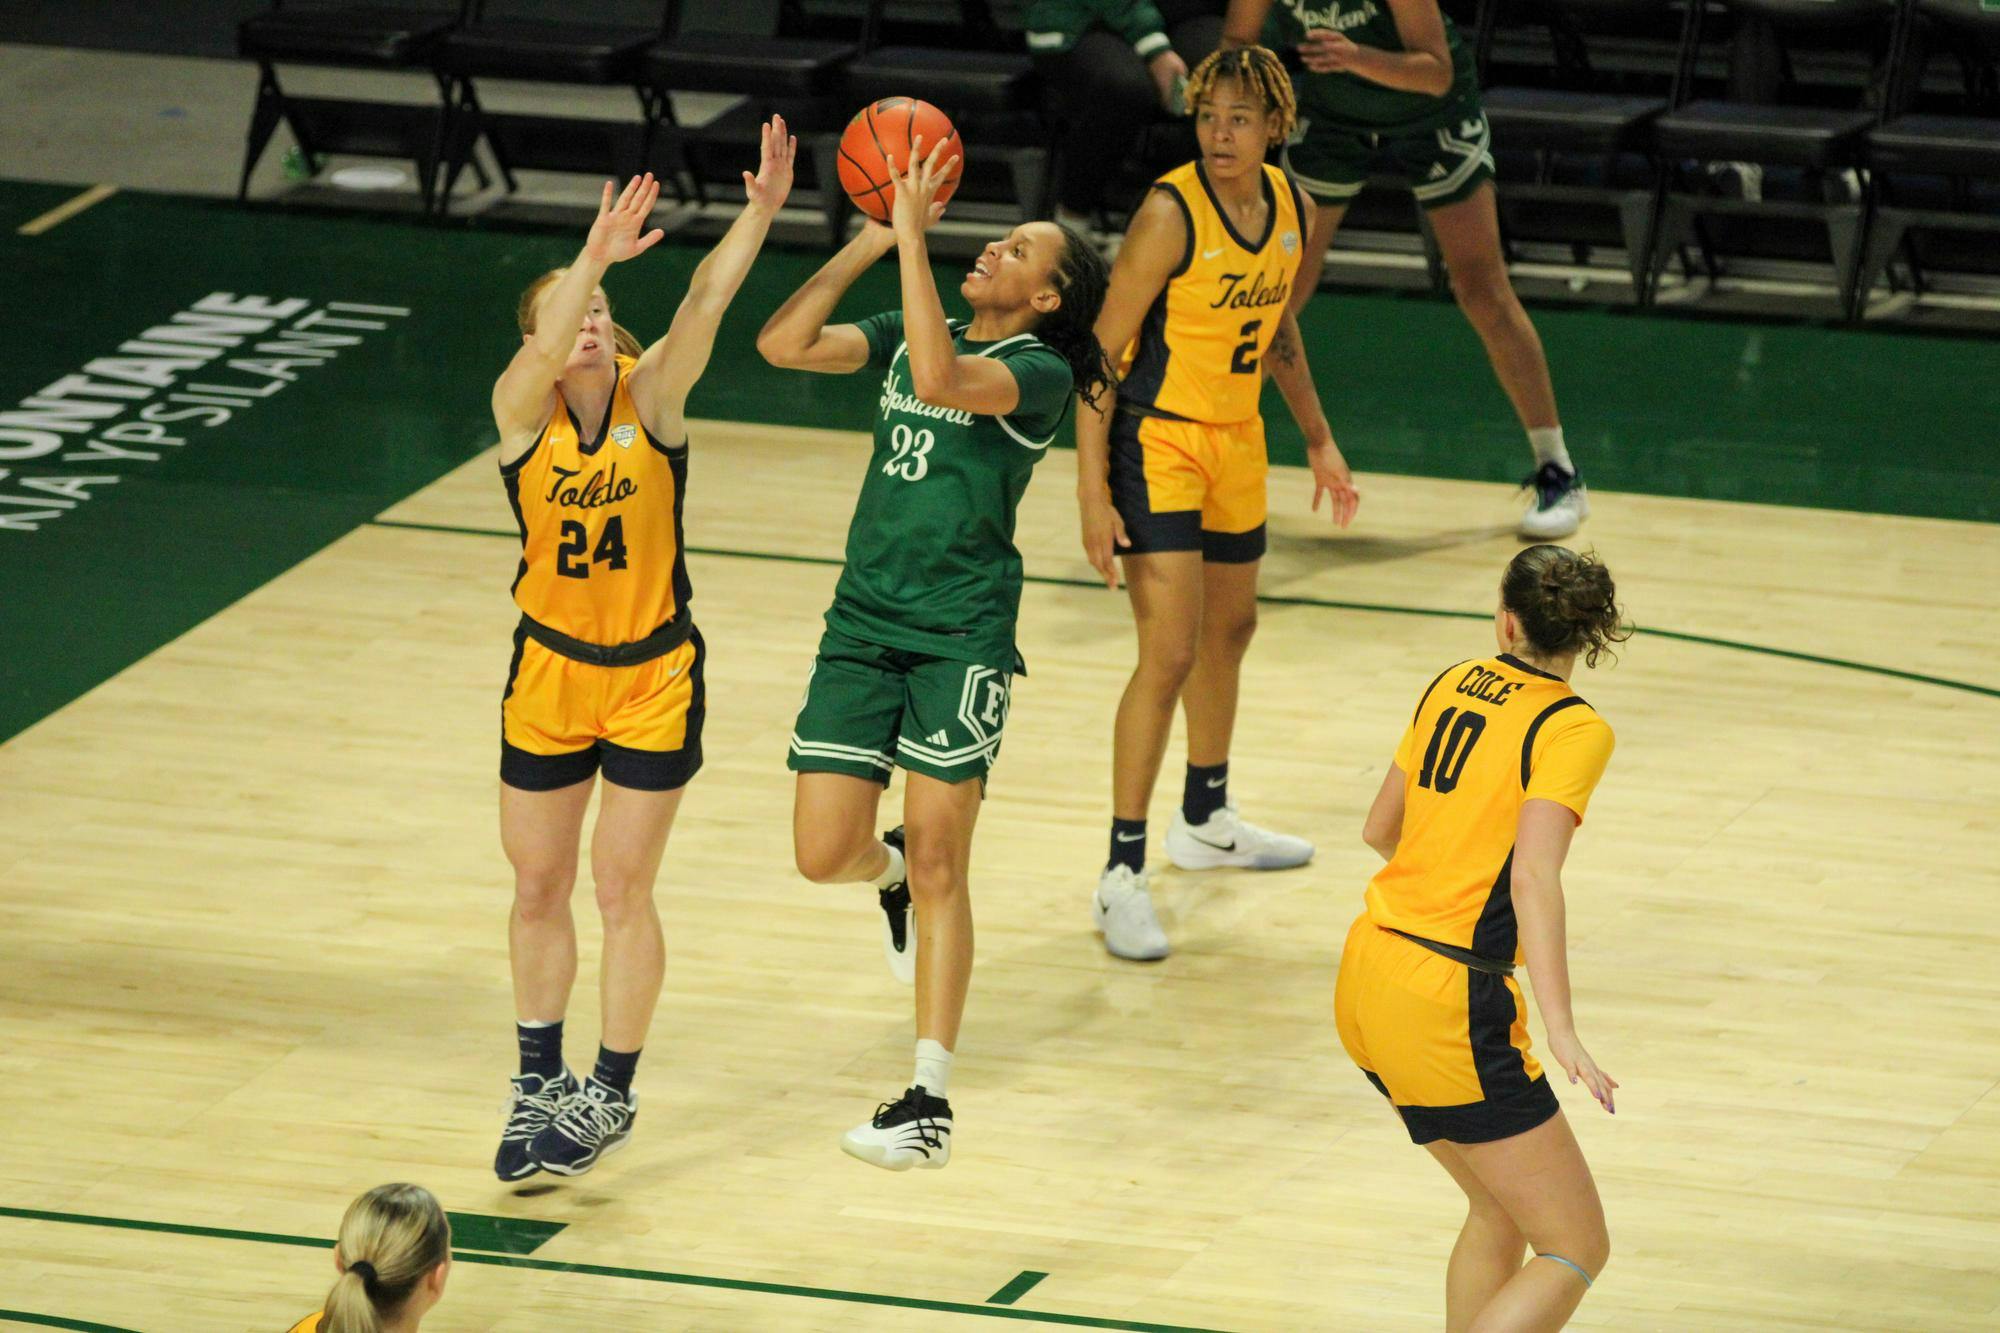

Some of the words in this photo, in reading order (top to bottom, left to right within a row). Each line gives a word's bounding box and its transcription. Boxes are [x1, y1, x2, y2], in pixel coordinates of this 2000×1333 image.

[1231, 319, 1263, 374] 2
[0, 291, 310, 481] ONTAINE
[62, 301, 412, 461] YPSILANTI
[882, 424, 935, 482] 23
[546, 462, 638, 509] Toledo
[557, 515, 628, 579] 24
[981, 680, 1005, 727] E
[1456, 665, 1525, 706] COLE
[1418, 706, 1487, 794] 10
